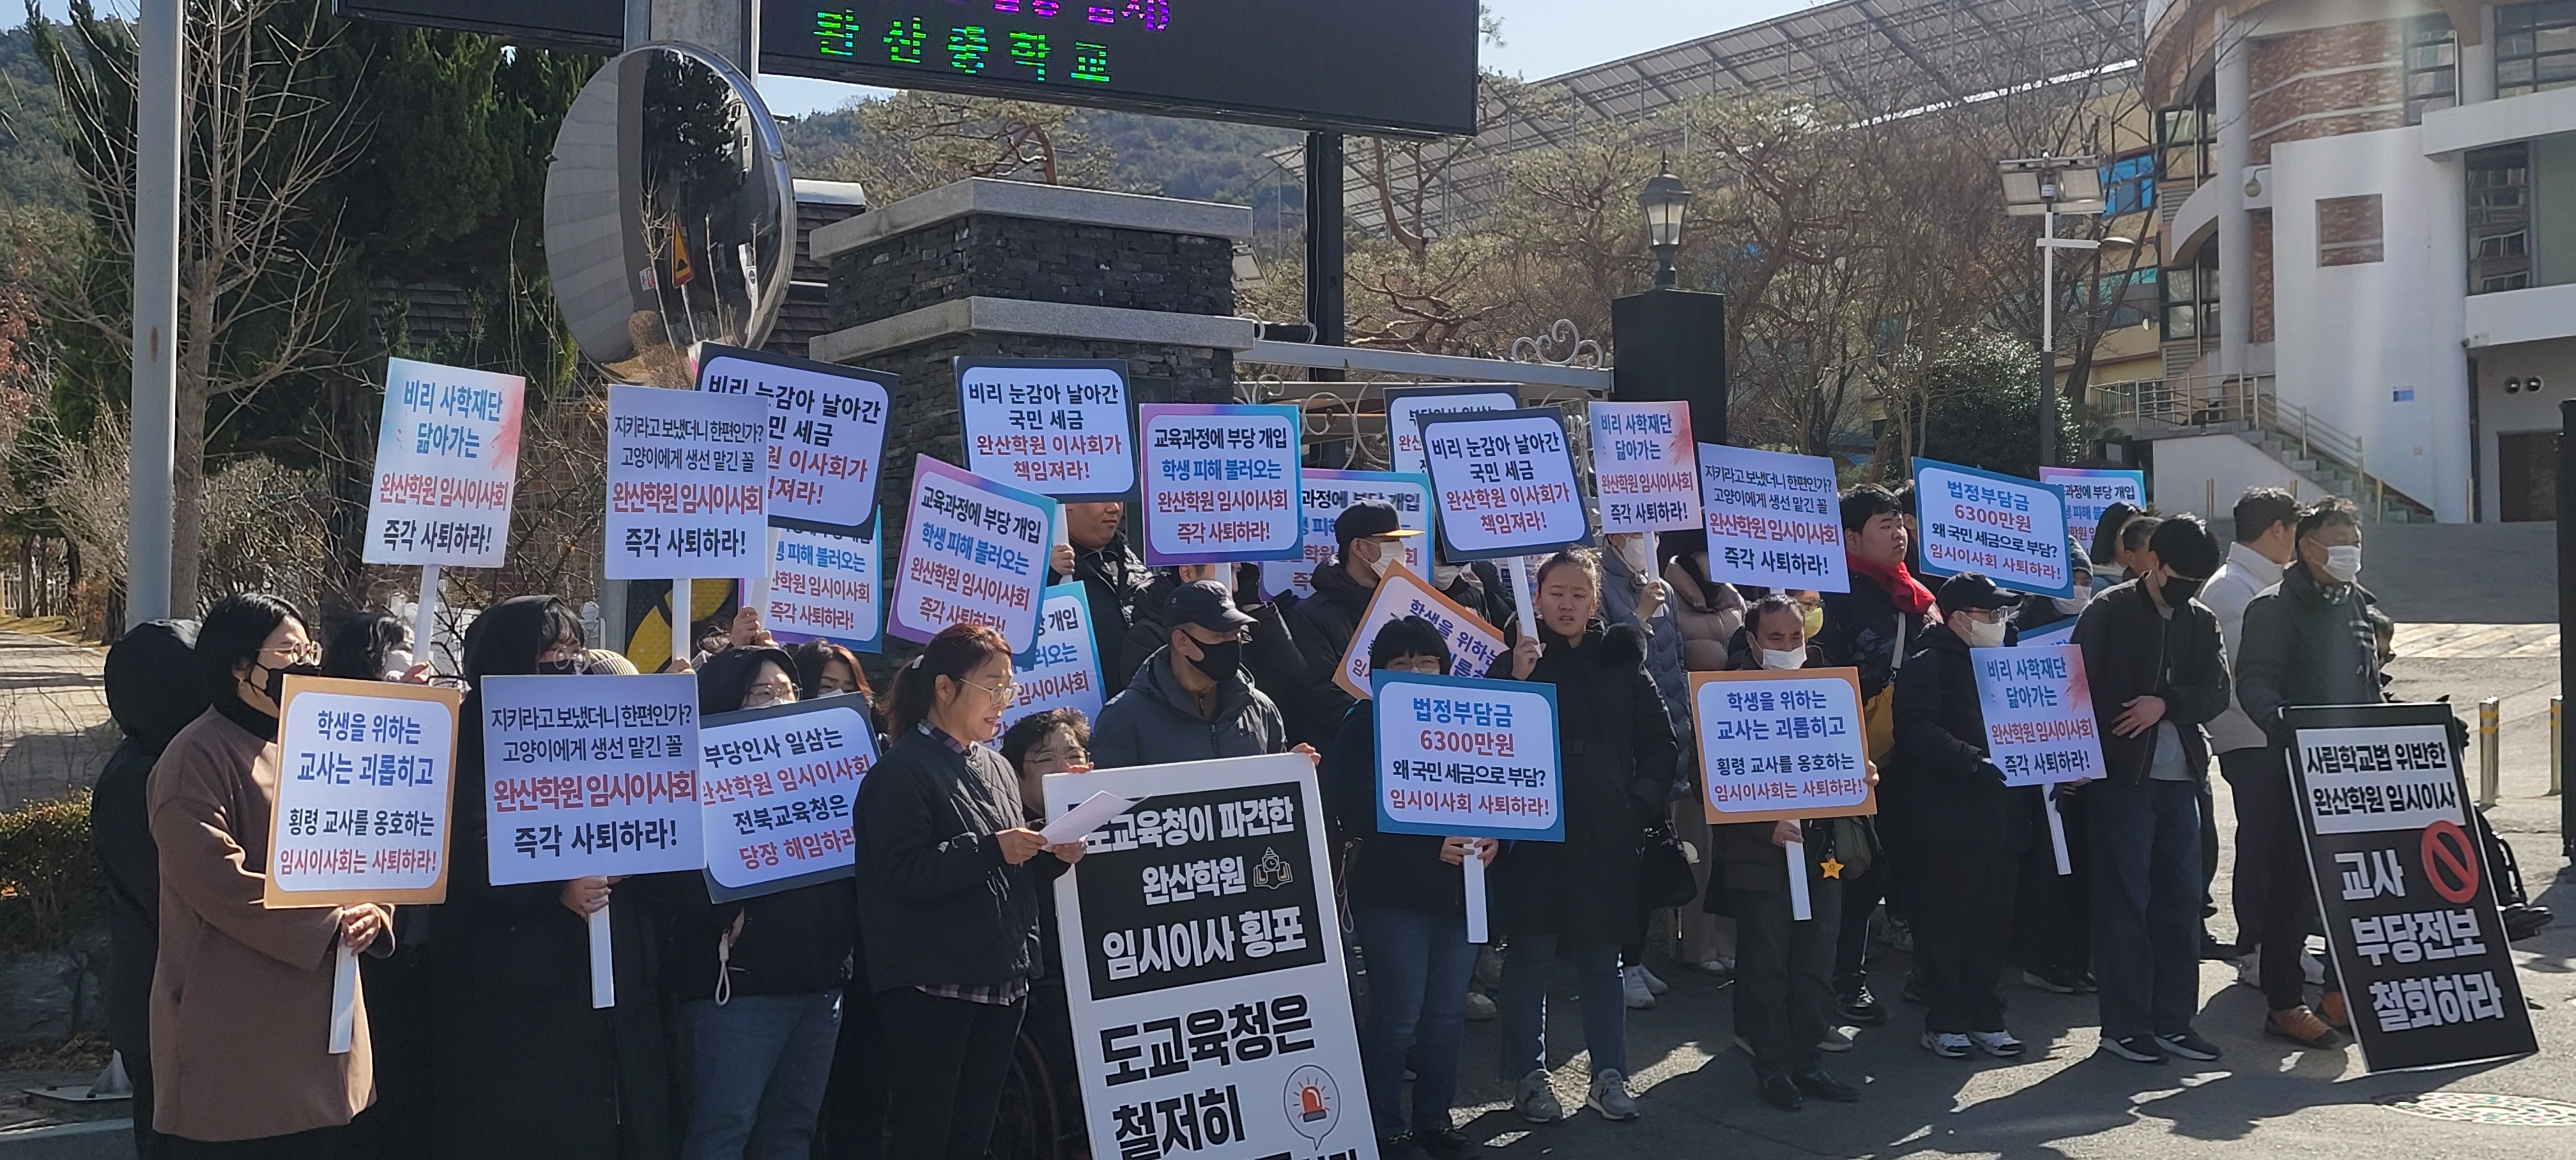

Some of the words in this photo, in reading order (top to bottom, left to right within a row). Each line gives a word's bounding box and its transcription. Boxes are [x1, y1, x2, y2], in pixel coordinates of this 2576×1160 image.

[404, 380, 435, 414] 비리
[440, 385, 502, 422] 사학재단
[969, 383, 1002, 404] 비리
[1009, 384, 1061, 404] 눈감아
[1067, 385, 1118, 404] 날아간
[822, 393, 880, 424] 날아간
[1009, 410, 1043, 430] 국민
[1050, 410, 1084, 430] 세금
[615, 415, 660, 438] 지키라고
[662, 419, 708, 441] 보냈더니
[710, 421, 763, 443] 한편인가?
[793, 420, 833, 446] 세금
[1601, 414, 1621, 434] 비리
[1626, 413, 1672, 434] 사학재단
[417, 423, 479, 458] 닮아가는
[977, 435, 1046, 455] 완산학원
[1053, 435, 1121, 455] 이사회가
[1154, 428, 1224, 449] 교육과정에
[1227, 428, 1255, 448] 부당
[1259, 428, 1287, 448] 개입
[1432, 438, 1462, 459] 비리
[1466, 436, 1510, 457] 눈감아
[1514, 432, 1561, 455] 날아간
[1616, 439, 1661, 461] 닮아가는
[621, 446, 682, 469] 고양이에게
[686, 449, 709, 470] 생선
[714, 450, 737, 471] 맡긴
[742, 452, 754, 472] 꼴
[789, 450, 868, 482] 이사회가
[1014, 461, 1089, 481] 책임져라!
[1162, 459, 1190, 481] 학생
[1194, 459, 1222, 480] 피해
[1225, 459, 1282, 480] 불러오는
[1470, 462, 1499, 483] 국민
[1505, 461, 1534, 482] 세금
[381, 473, 438, 505] 완산학원
[440, 478, 509, 510] 임시이사회
[1602, 474, 1638, 494] 완산학원
[1639, 471, 1693, 493] 임시이사회
[1705, 465, 1744, 484] 지키라고
[1746, 470, 1786, 489] 보냈더니
[1786, 474, 1832, 492] 한편인가?
[613, 482, 677, 513] 완산학원
[680, 484, 763, 515] 임시이사회
[1158, 491, 1214, 512] 완산학원
[1218, 489, 1287, 512] 임시이사회
[1446, 487, 1506, 512] 완산학원
[1510, 482, 1570, 507] 이사회가
[1714, 488, 1767, 508] 고양이에게
[1769, 494, 1791, 511] 생선
[1793, 497, 1814, 513] 맡긴
[1816, 498, 1828, 514] 꼴
[1948, 481, 2029, 512] 법정부담금
[2093, 486, 2112, 500] 부당
[2115, 486, 2135, 500] 개입
[921, 487, 981, 527] 교육과정에
[983, 506, 1011, 535] 부당
[1013, 517, 1041, 544] 개입
[1480, 512, 1547, 535] 책임져라!
[1611, 503, 1631, 524] 즉각
[1636, 501, 1688, 523] 사퇴하라!
[1955, 504, 2031, 533] 6300만원
[383, 520, 416, 551] 즉각
[420, 521, 491, 554] 사퇴하라!
[625, 528, 661, 557] 즉각
[667, 528, 745, 557] 사퇴하라!
[1177, 523, 1206, 544] 즉각
[1209, 521, 1269, 542] 사퇴하라!
[1710, 513, 1767, 540] 완산학원
[1768, 519, 1839, 546] 임시이사회
[1932, 523, 1945, 538] 왜
[1947, 525, 1972, 543] 국민
[1975, 531, 2025, 552] 세금으로
[2027, 540, 2057, 558] 부담?
[788, 544, 813, 565] 피해
[816, 547, 865, 572] 불러오는
[923, 523, 946, 551] 학생
[947, 533, 974, 560] 피해
[975, 540, 1029, 576] 불러오는
[1725, 547, 1754, 570] 즉각
[1761, 551, 1829, 576] 사퇴하라!
[1930, 544, 1997, 569] 임시이사회
[2003, 560, 2060, 580] 사퇴하라!
[809, 576, 870, 603] 임시이사회
[911, 557, 960, 592] 완산학원
[962, 572, 1030, 611] 임시이사회
[770, 602, 797, 623] 즉각
[799, 605, 854, 630] 사퇴하라!
[920, 597, 946, 625] 즉각
[1048, 607, 1078, 631] 개입
[1986, 659, 2012, 682] 비리
[2016, 657, 2067, 680] 사학재단
[1727, 691, 1774, 712] 학생을
[1781, 690, 1827, 710] 위하는
[2006, 685, 2057, 708] 닮아가는
[318, 710, 365, 742] 학생을
[372, 715, 421, 744] 위하는
[491, 707, 555, 731] 지키라고
[557, 705, 619, 729] 보냈더니
[621, 703, 692, 728] 한편인가?
[1413, 698, 1513, 728] 법정부담금
[1717, 719, 1769, 741] 교사는
[1776, 715, 1846, 739] 괴롭히고
[1991, 721, 2036, 745] 완산학원
[2036, 718, 2094, 742] 임시이사회
[503, 738, 586, 763] 고양이에게
[591, 736, 624, 759] 생선
[628, 735, 661, 759] 맡긴
[666, 735, 682, 757] 꼴
[704, 735, 781, 768] 부당인사
[785, 728, 843, 754] 일삼는
[1420, 729, 1514, 758] 6300만원
[2308, 743, 2393, 774] 사립학교법
[2395, 741, 2447, 768] 위반한
[298, 752, 353, 784] 교사는
[359, 753, 433, 787] 괴롭히고
[777, 754, 871, 792] 임시이사회
[1393, 759, 1408, 780] 왜
[1411, 761, 1441, 782] 국민
[1445, 763, 1506, 784] 세금으로
[1508, 767, 1546, 788] 부담?
[1717, 758, 1745, 776] 횡령
[1751, 755, 1793, 774] 교사를
[1798, 753, 1854, 772] 옹호하는
[2004, 754, 2030, 777] 즉각
[2034, 750, 2090, 774] 사퇴하라!
[494, 775, 583, 813] 완산학원
[586, 770, 697, 807] 임시이사회
[1390, 789, 1471, 813] 임시이사회
[1478, 795, 1549, 817] 사퇴하라!
[1715, 782, 1797, 802] 임시이사회는
[1803, 778, 1862, 797] 사퇴하라!
[2313, 786, 2385, 816] 완산학원
[2387, 782, 2456, 811] 임시이사
[289, 808, 318, 836] 횡령
[323, 809, 369, 836] 교사를
[374, 810, 434, 837] 옹호하는
[733, 795, 848, 836] 전북교육청은
[1218, 796, 1295, 839] 파견한
[514, 825, 562, 859] 즉각
[571, 818, 677, 855] 사퇴하라!
[280, 849, 367, 875] 임시이사회는
[372, 849, 436, 874] 사퇴하라!
[739, 841, 779, 869] 당장
[1142, 855, 1246, 906] 완산학원
[2334, 849, 2405, 900] 교사
[1103, 915, 1235, 981] 임시이사
[1239, 906, 1307, 958] 횡포
[2351, 908, 2487, 966] 부당전보
[2369, 971, 2504, 1033] 철회하라
[1100, 994, 1315, 1087] 도교육청은
[1112, 1084, 1245, 1160] 철저히
